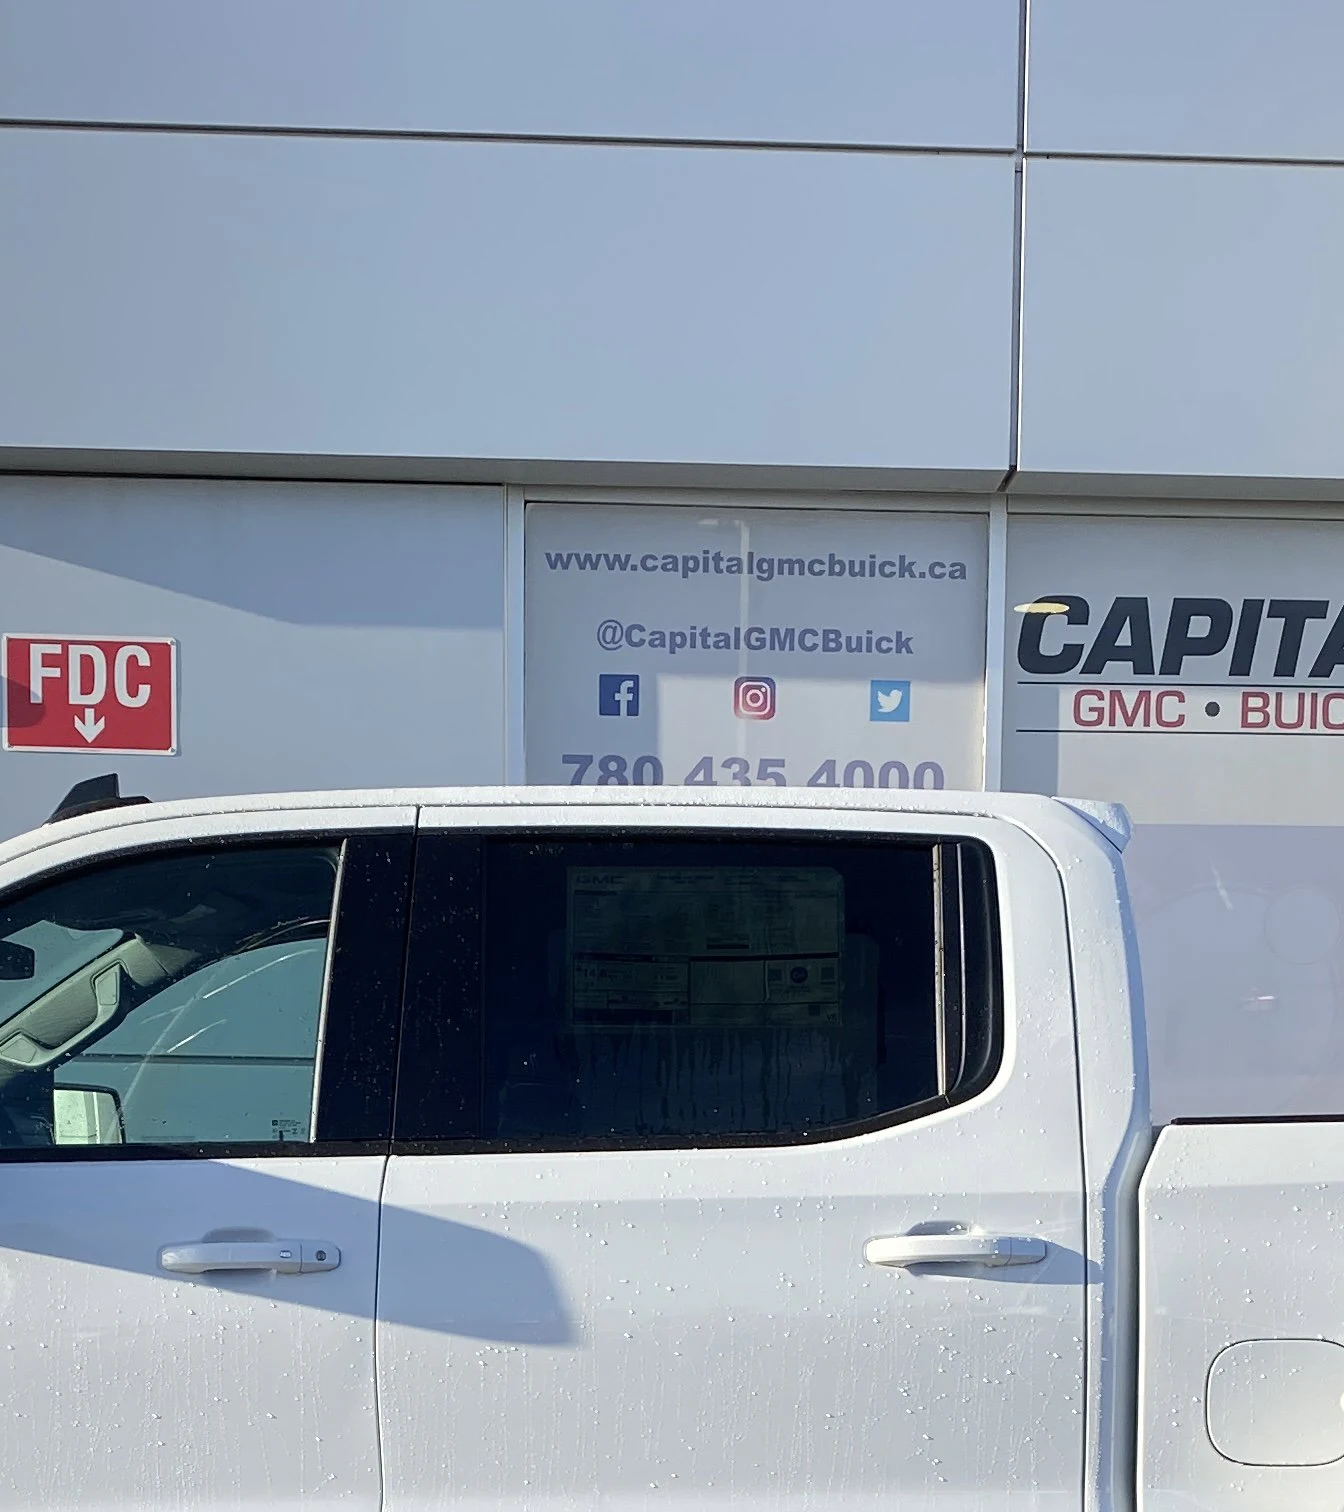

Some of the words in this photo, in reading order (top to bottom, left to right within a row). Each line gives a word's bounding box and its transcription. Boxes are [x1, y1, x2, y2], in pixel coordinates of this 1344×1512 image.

[545, 549, 967, 582] www.capitalgmcbuick.ca
[597, 619, 914, 655] @CapitalGMCBuick
[29, 643, 151, 708] FDC
[1072, 689, 1186, 728] GMC
[561, 754, 664, 786] 780
[683, 756, 787, 787] 435
[807, 759, 945, 790] 4000
